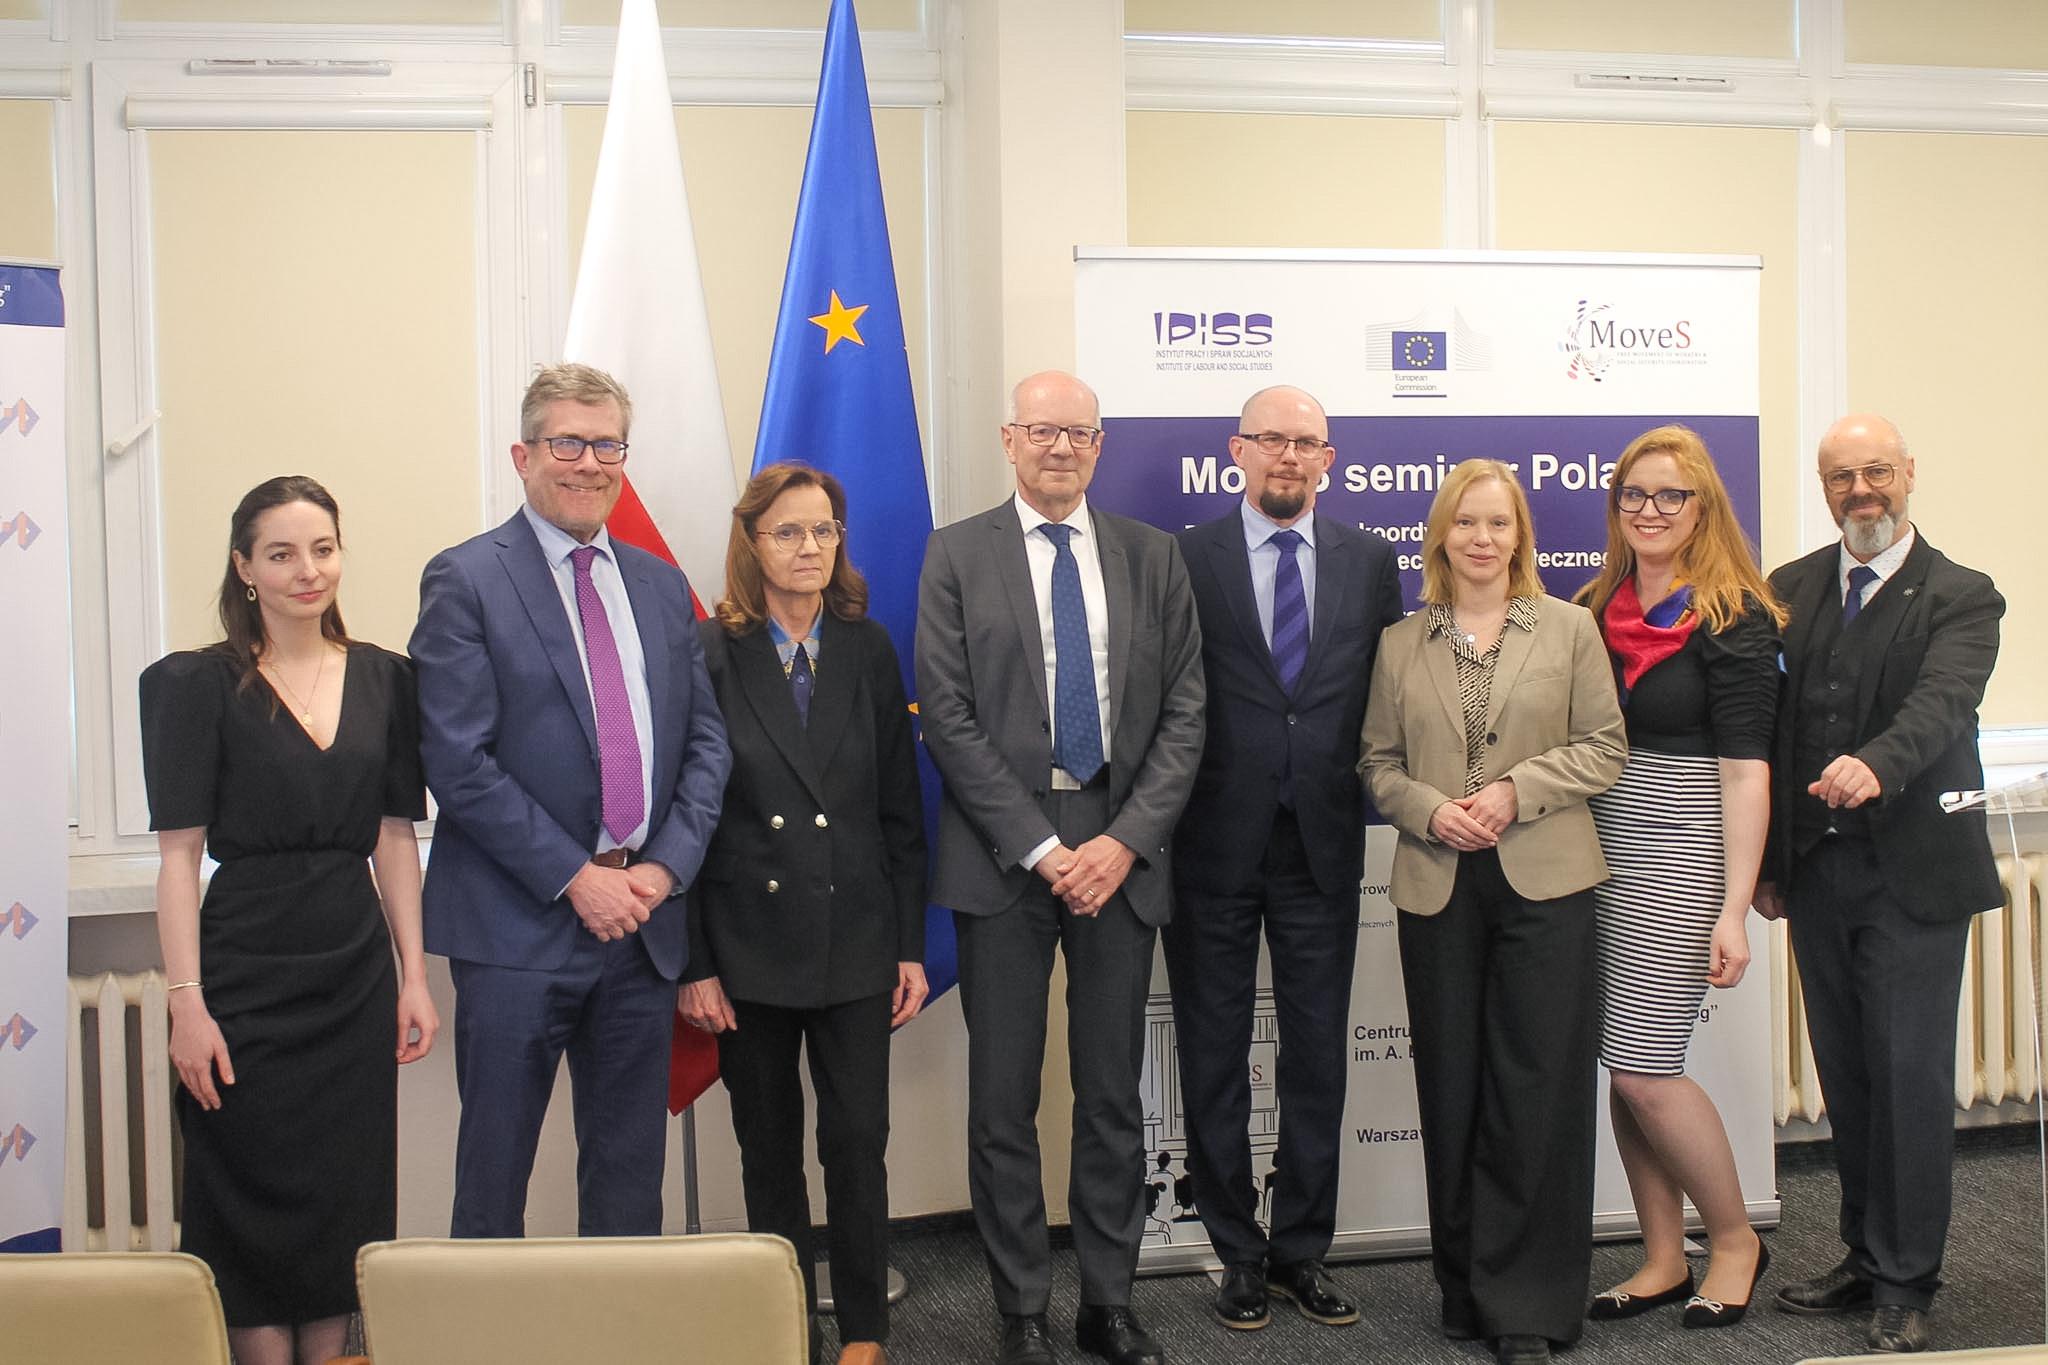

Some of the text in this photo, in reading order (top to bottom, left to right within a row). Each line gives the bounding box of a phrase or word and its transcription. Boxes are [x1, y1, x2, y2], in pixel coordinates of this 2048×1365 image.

[1590, 320, 1691, 349] MoveS
[1395, 374, 1428, 382] European
[1531, 453, 1617, 490] Pola
[1354, 1025, 1411, 1040] Centru
[1354, 1047, 1380, 1062] im.
[1385, 1045, 1402, 1060] A.
[1356, 1127, 1423, 1143] Warsza
